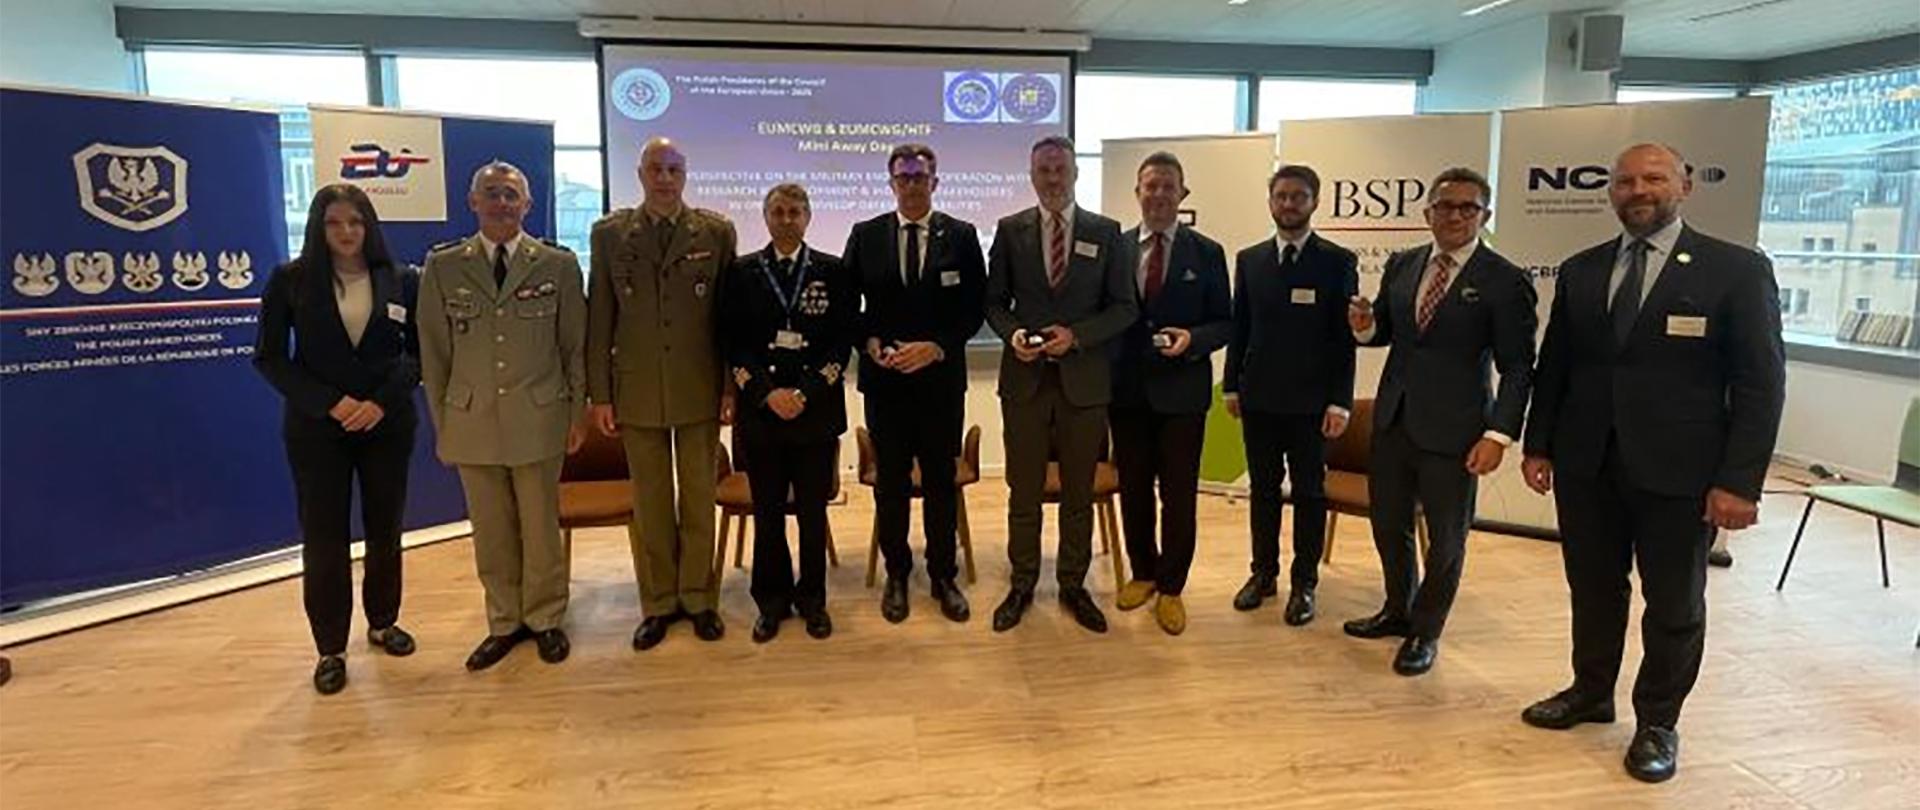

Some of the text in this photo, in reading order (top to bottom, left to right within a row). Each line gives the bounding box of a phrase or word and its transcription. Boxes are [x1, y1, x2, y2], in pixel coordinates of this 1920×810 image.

[824, 124, 836, 135] &
[798, 140, 829, 151] Mini
[832, 141, 866, 153] Away
[764, 171, 783, 181] ON
[1329, 179, 1425, 219] BSP
[75, 341, 98, 350] THE
[100, 339, 140, 348] POLISH
[184, 333, 222, 342] FORCES
[22, 360, 70, 371] FORCES
[121, 356, 136, 364] DE
